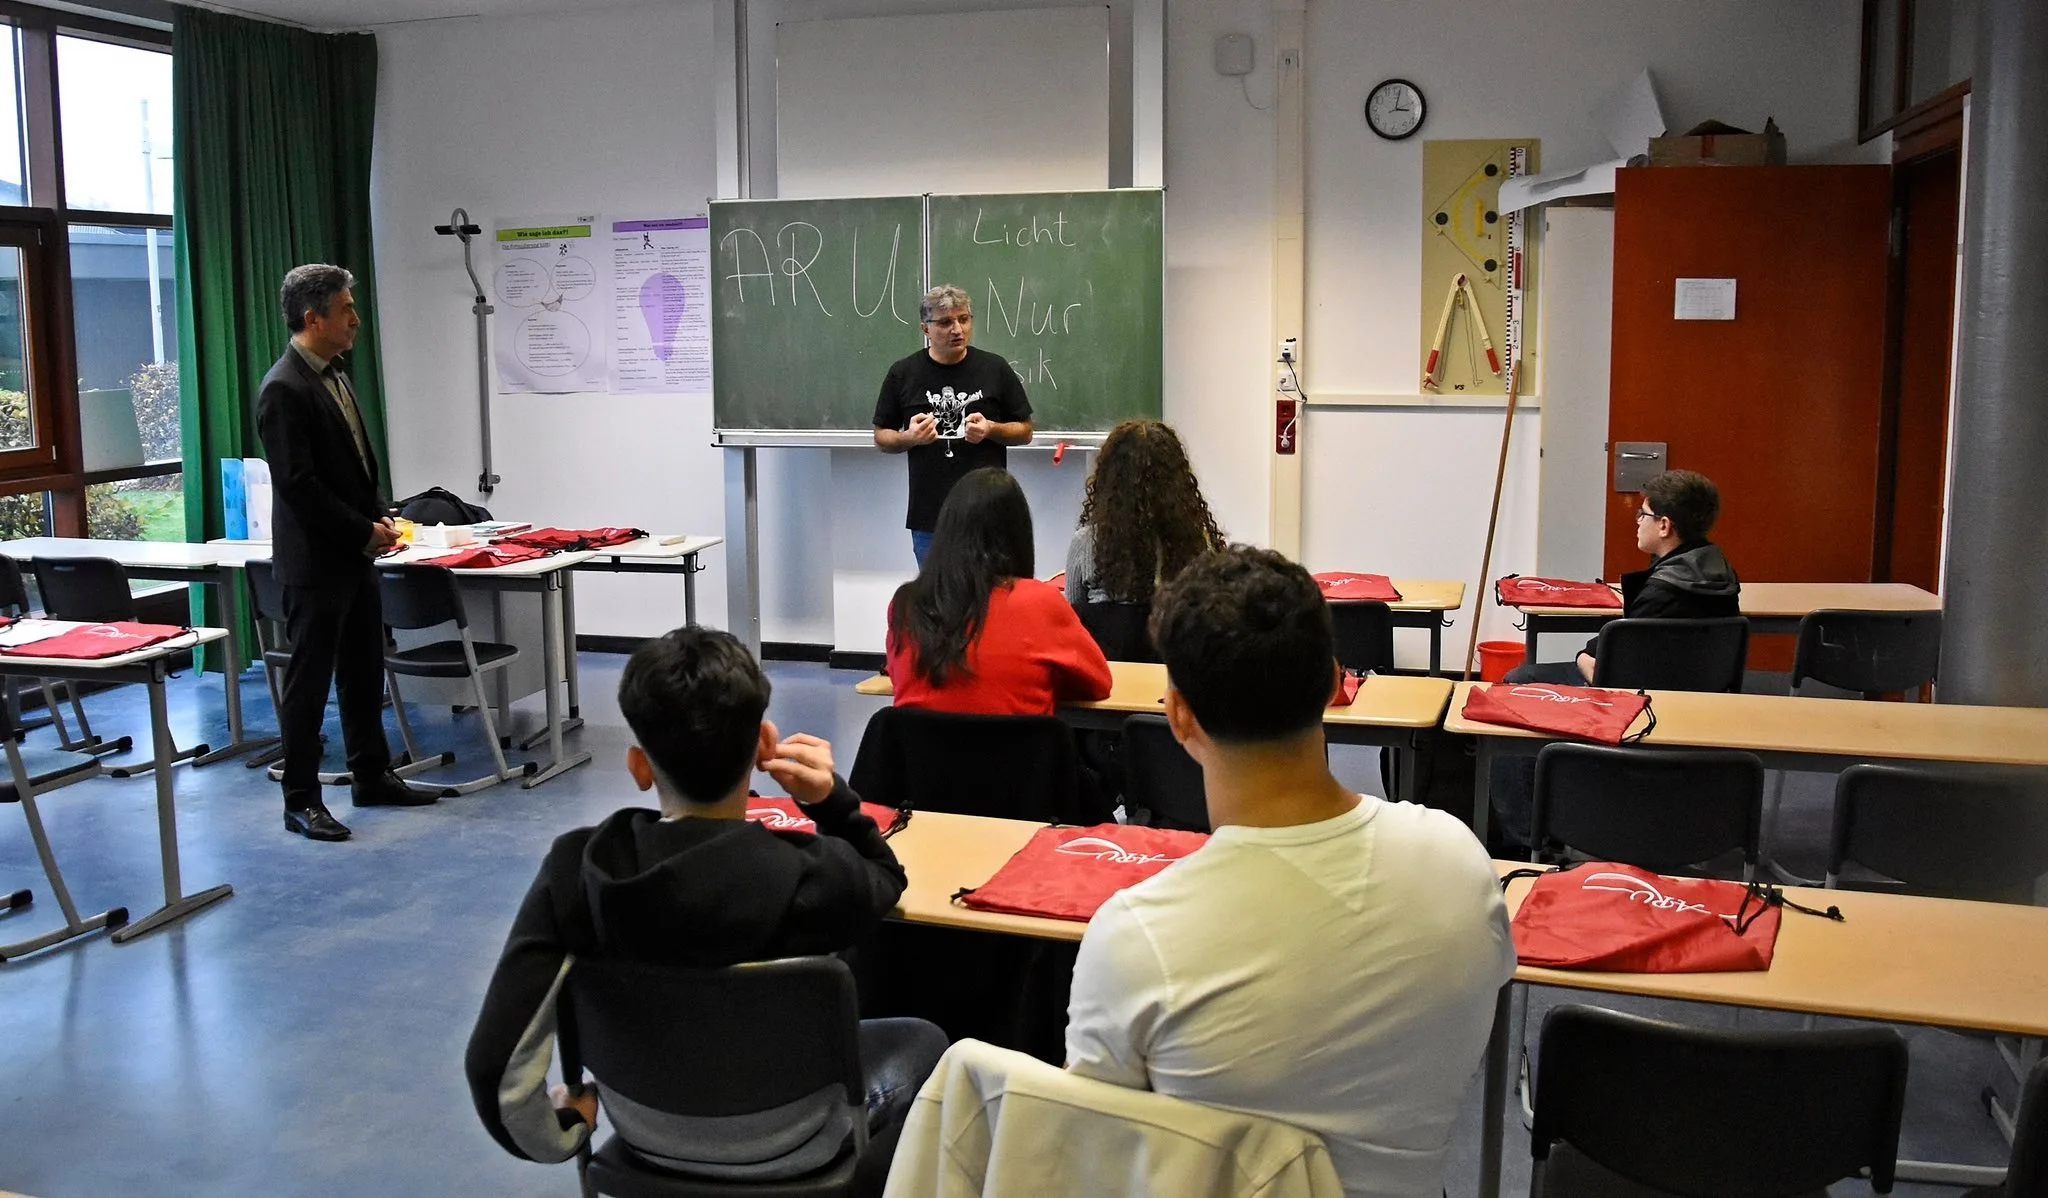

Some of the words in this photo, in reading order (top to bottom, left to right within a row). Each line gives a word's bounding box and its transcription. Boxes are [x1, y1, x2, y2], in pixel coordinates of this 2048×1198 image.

[973, 207, 1077, 247] Licht
[720, 221, 909, 325] ARU
[986, 276, 1082, 338] Nur
